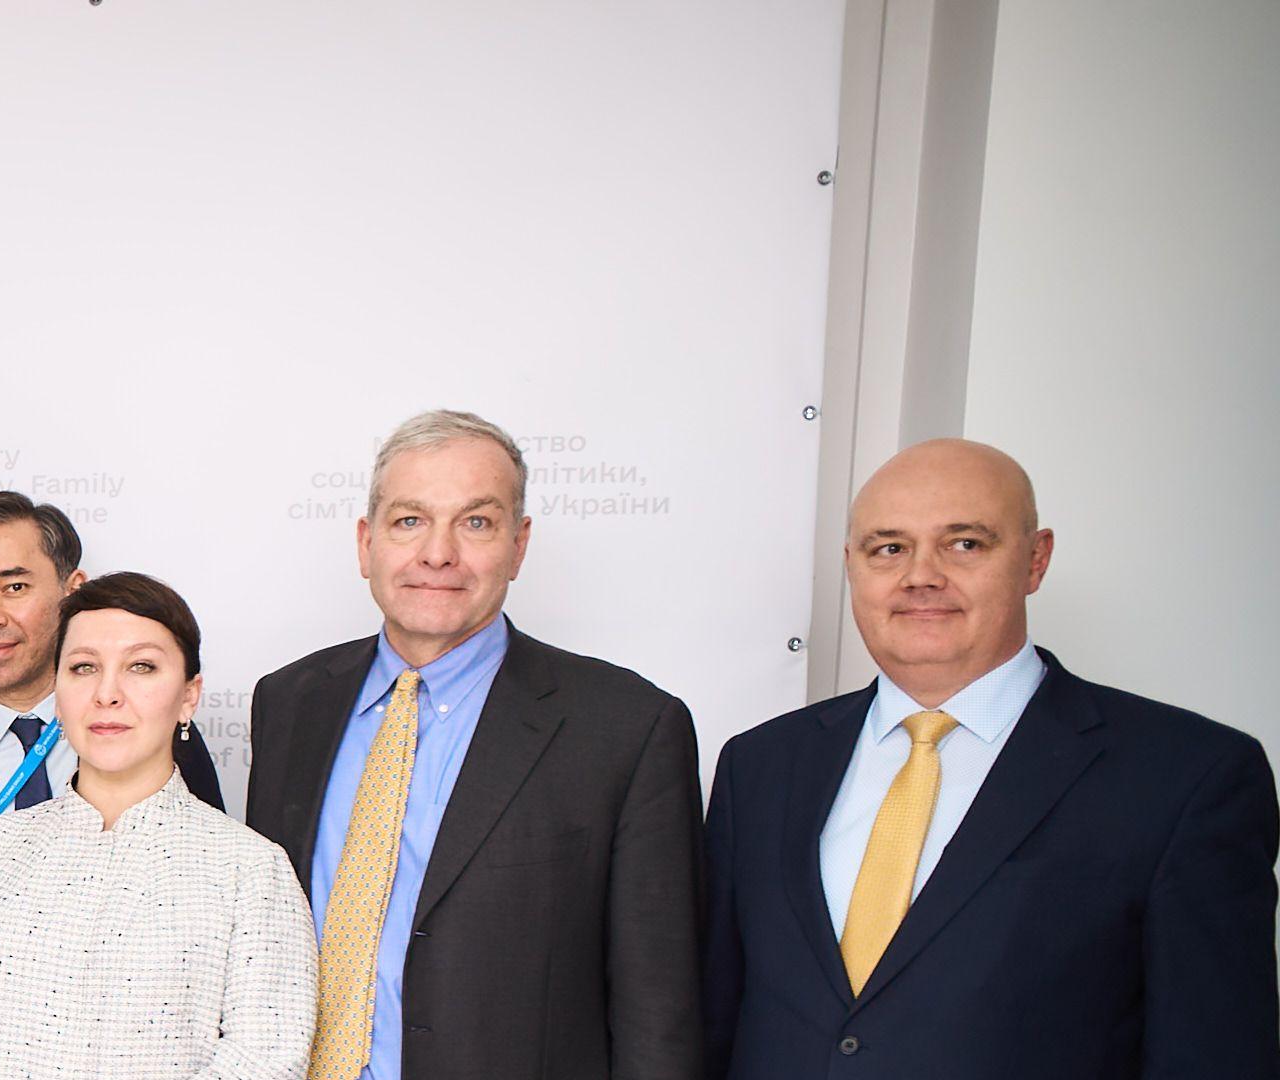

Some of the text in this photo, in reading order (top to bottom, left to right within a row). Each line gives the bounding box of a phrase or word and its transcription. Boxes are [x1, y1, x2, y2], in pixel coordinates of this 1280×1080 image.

[31, 473, 126, 498] Family
[529, 461, 648, 487] літики,
[539, 492, 670, 520] України
